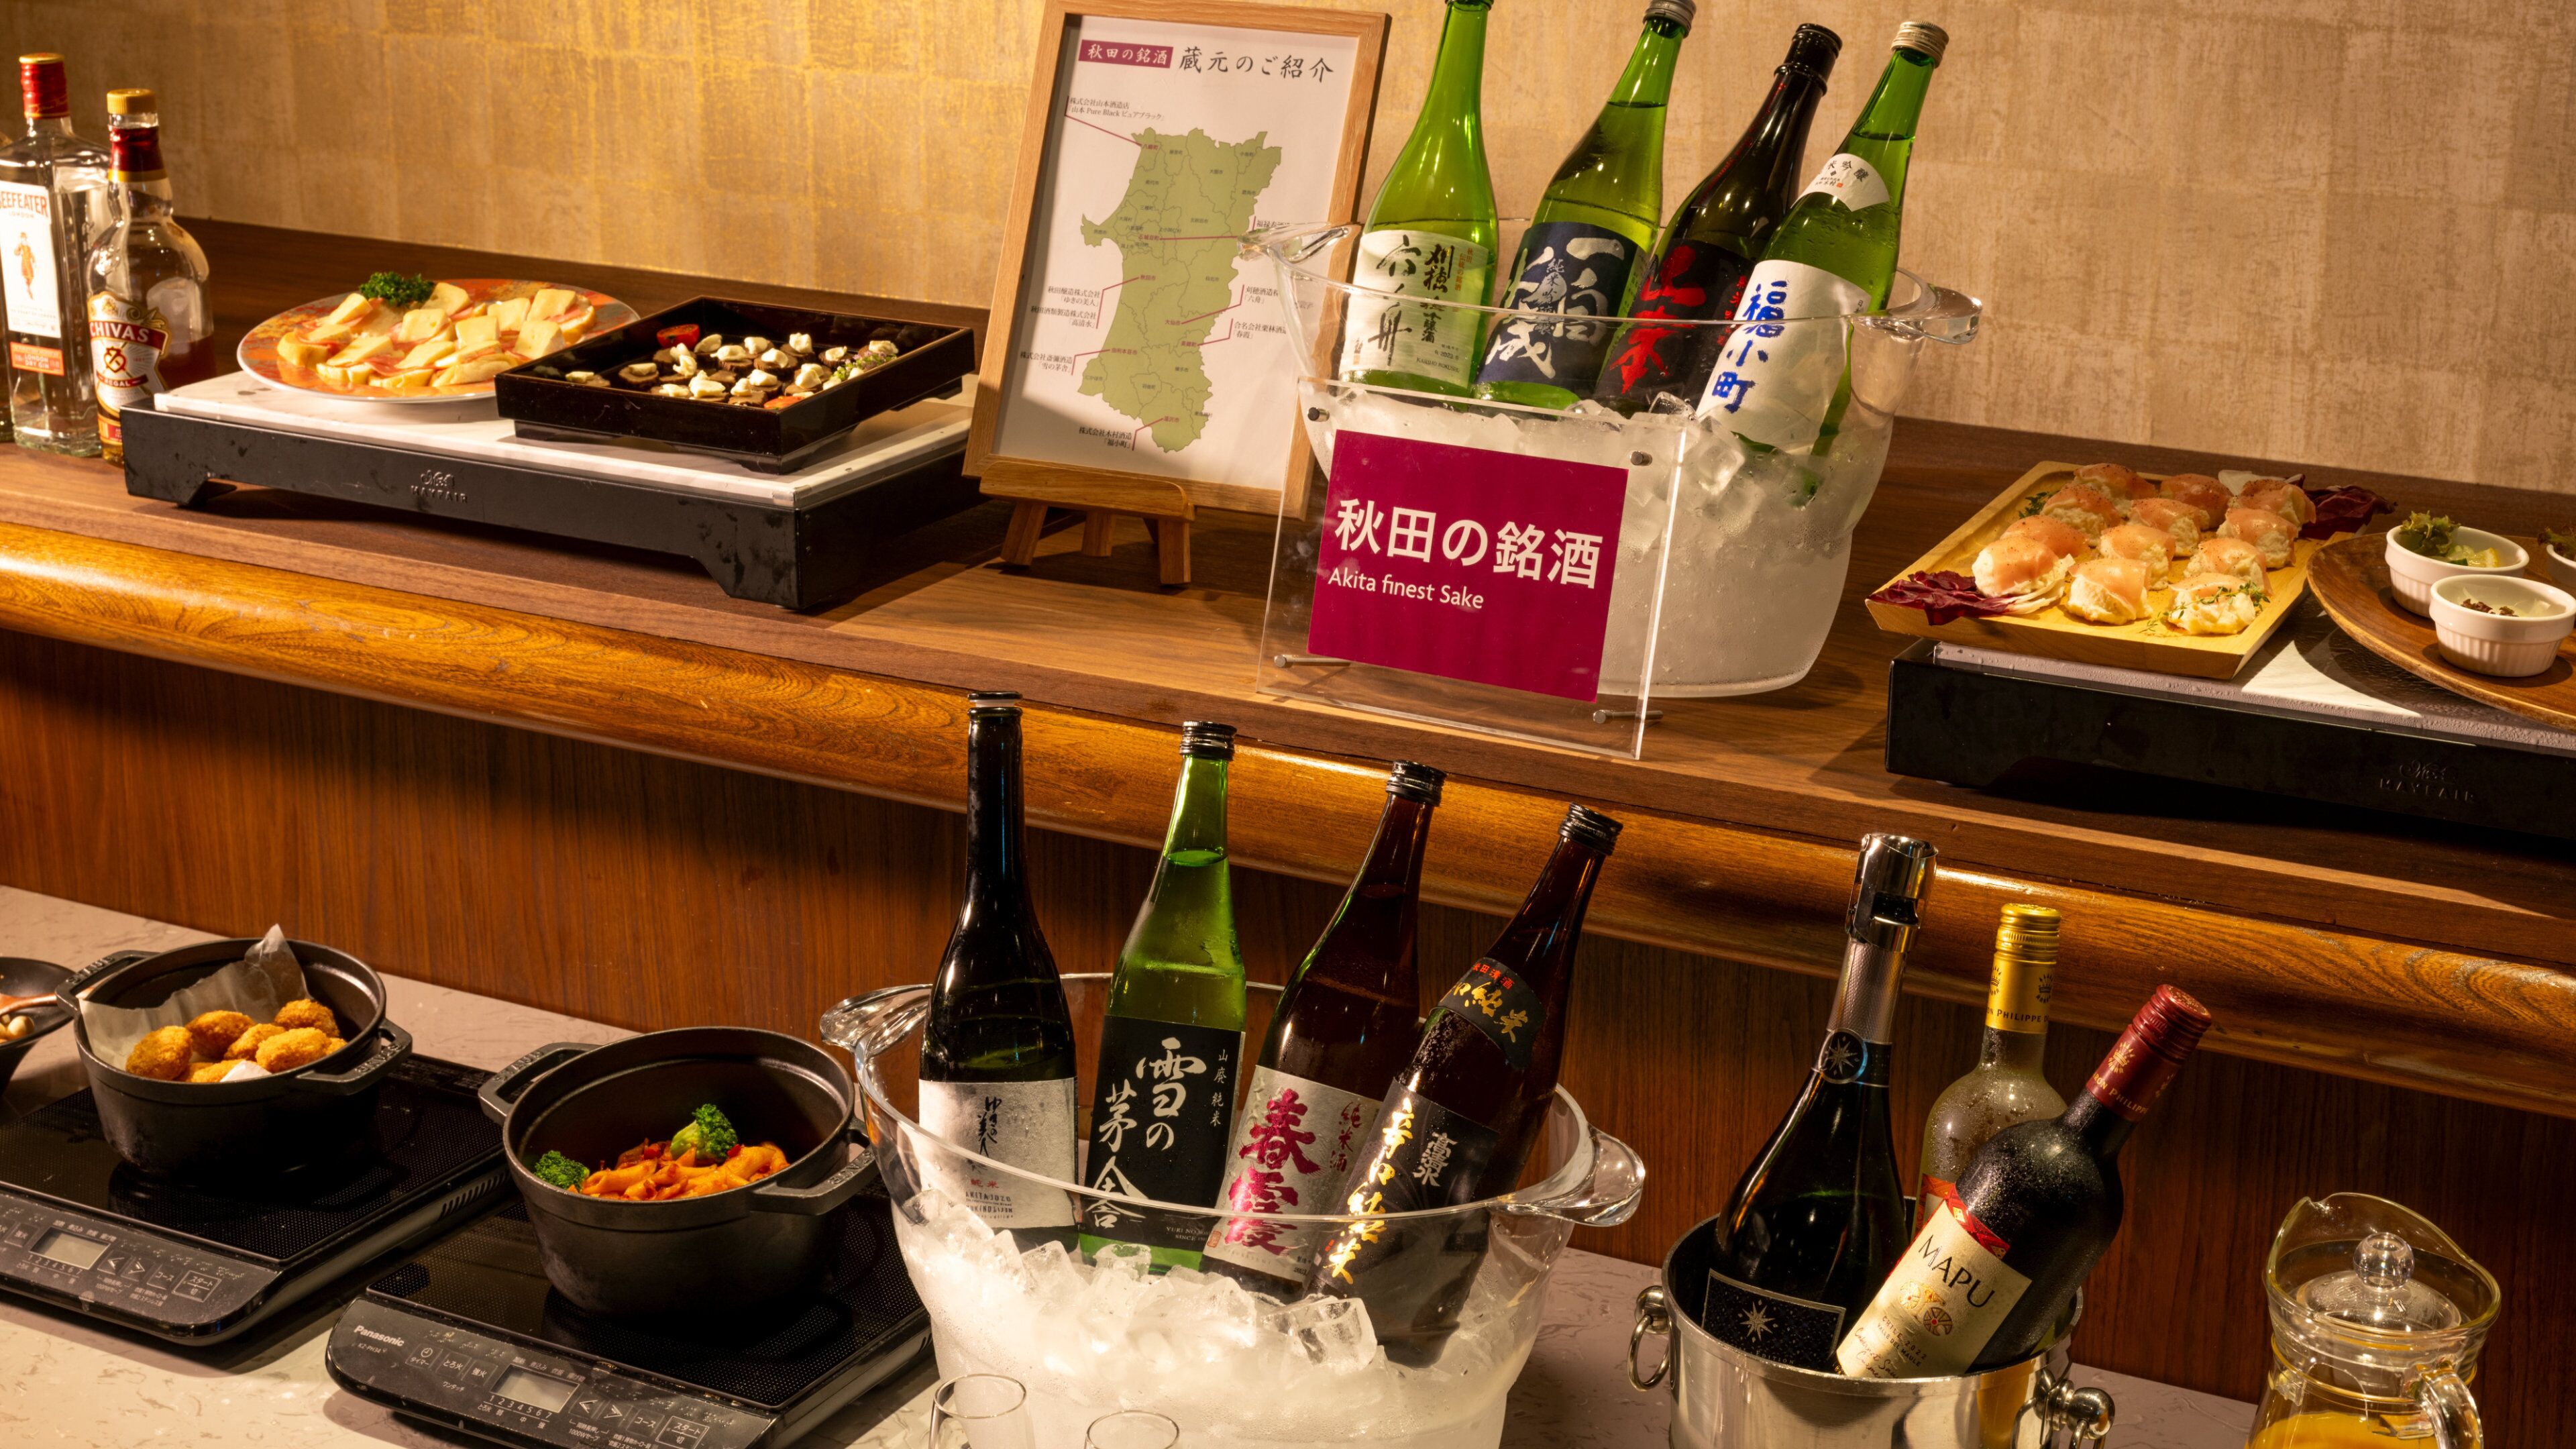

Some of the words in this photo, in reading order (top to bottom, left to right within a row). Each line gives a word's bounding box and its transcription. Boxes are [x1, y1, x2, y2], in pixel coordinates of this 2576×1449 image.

[1087, 43, 1167, 65] 秋田の銘酒
[1179, 46, 1334, 83] 蔵元のご紹介
[1103, 109, 1120, 117] Black
[0, 191, 48, 217] EEFEATER
[89, 321, 150, 343] CHIVAS
[1712, 280, 1790, 413] 福小町
[104, 378, 131, 387] REGAL
[411, 485, 468, 503] MAYFAIR
[1335, 498, 1603, 589] 秋田の銘酒
[1328, 568, 1376, 592] Akita
[1382, 574, 1435, 602] finest
[1440, 584, 1485, 609] Sake
[1996, 1009, 2041, 1022] PHILIPPE
[1136, 1037, 1207, 1151] 雪の
[1330, 1101, 1362, 1173] 純米酒
[1412, 1132, 1458, 1187] 高清水
[154, 1271, 174, 1282] コース
[189, 1276, 213, 1287] スタート
[1918, 1234, 1996, 1308] MAPU
[354, 1325, 405, 1347] Panasonic
[1890, 1338, 1900, 1349] DEL
[1901, 1348, 1922, 1367] MAULE
[1905, 1340, 1927, 1360] 2022
[410, 1356, 429, 1366] タイマー
[443, 1358, 464, 1370] とろ火
[472, 1367, 487, 1378] 強火
[635, 1417, 656, 1428] コース
[674, 1422, 700, 1435] スタート
